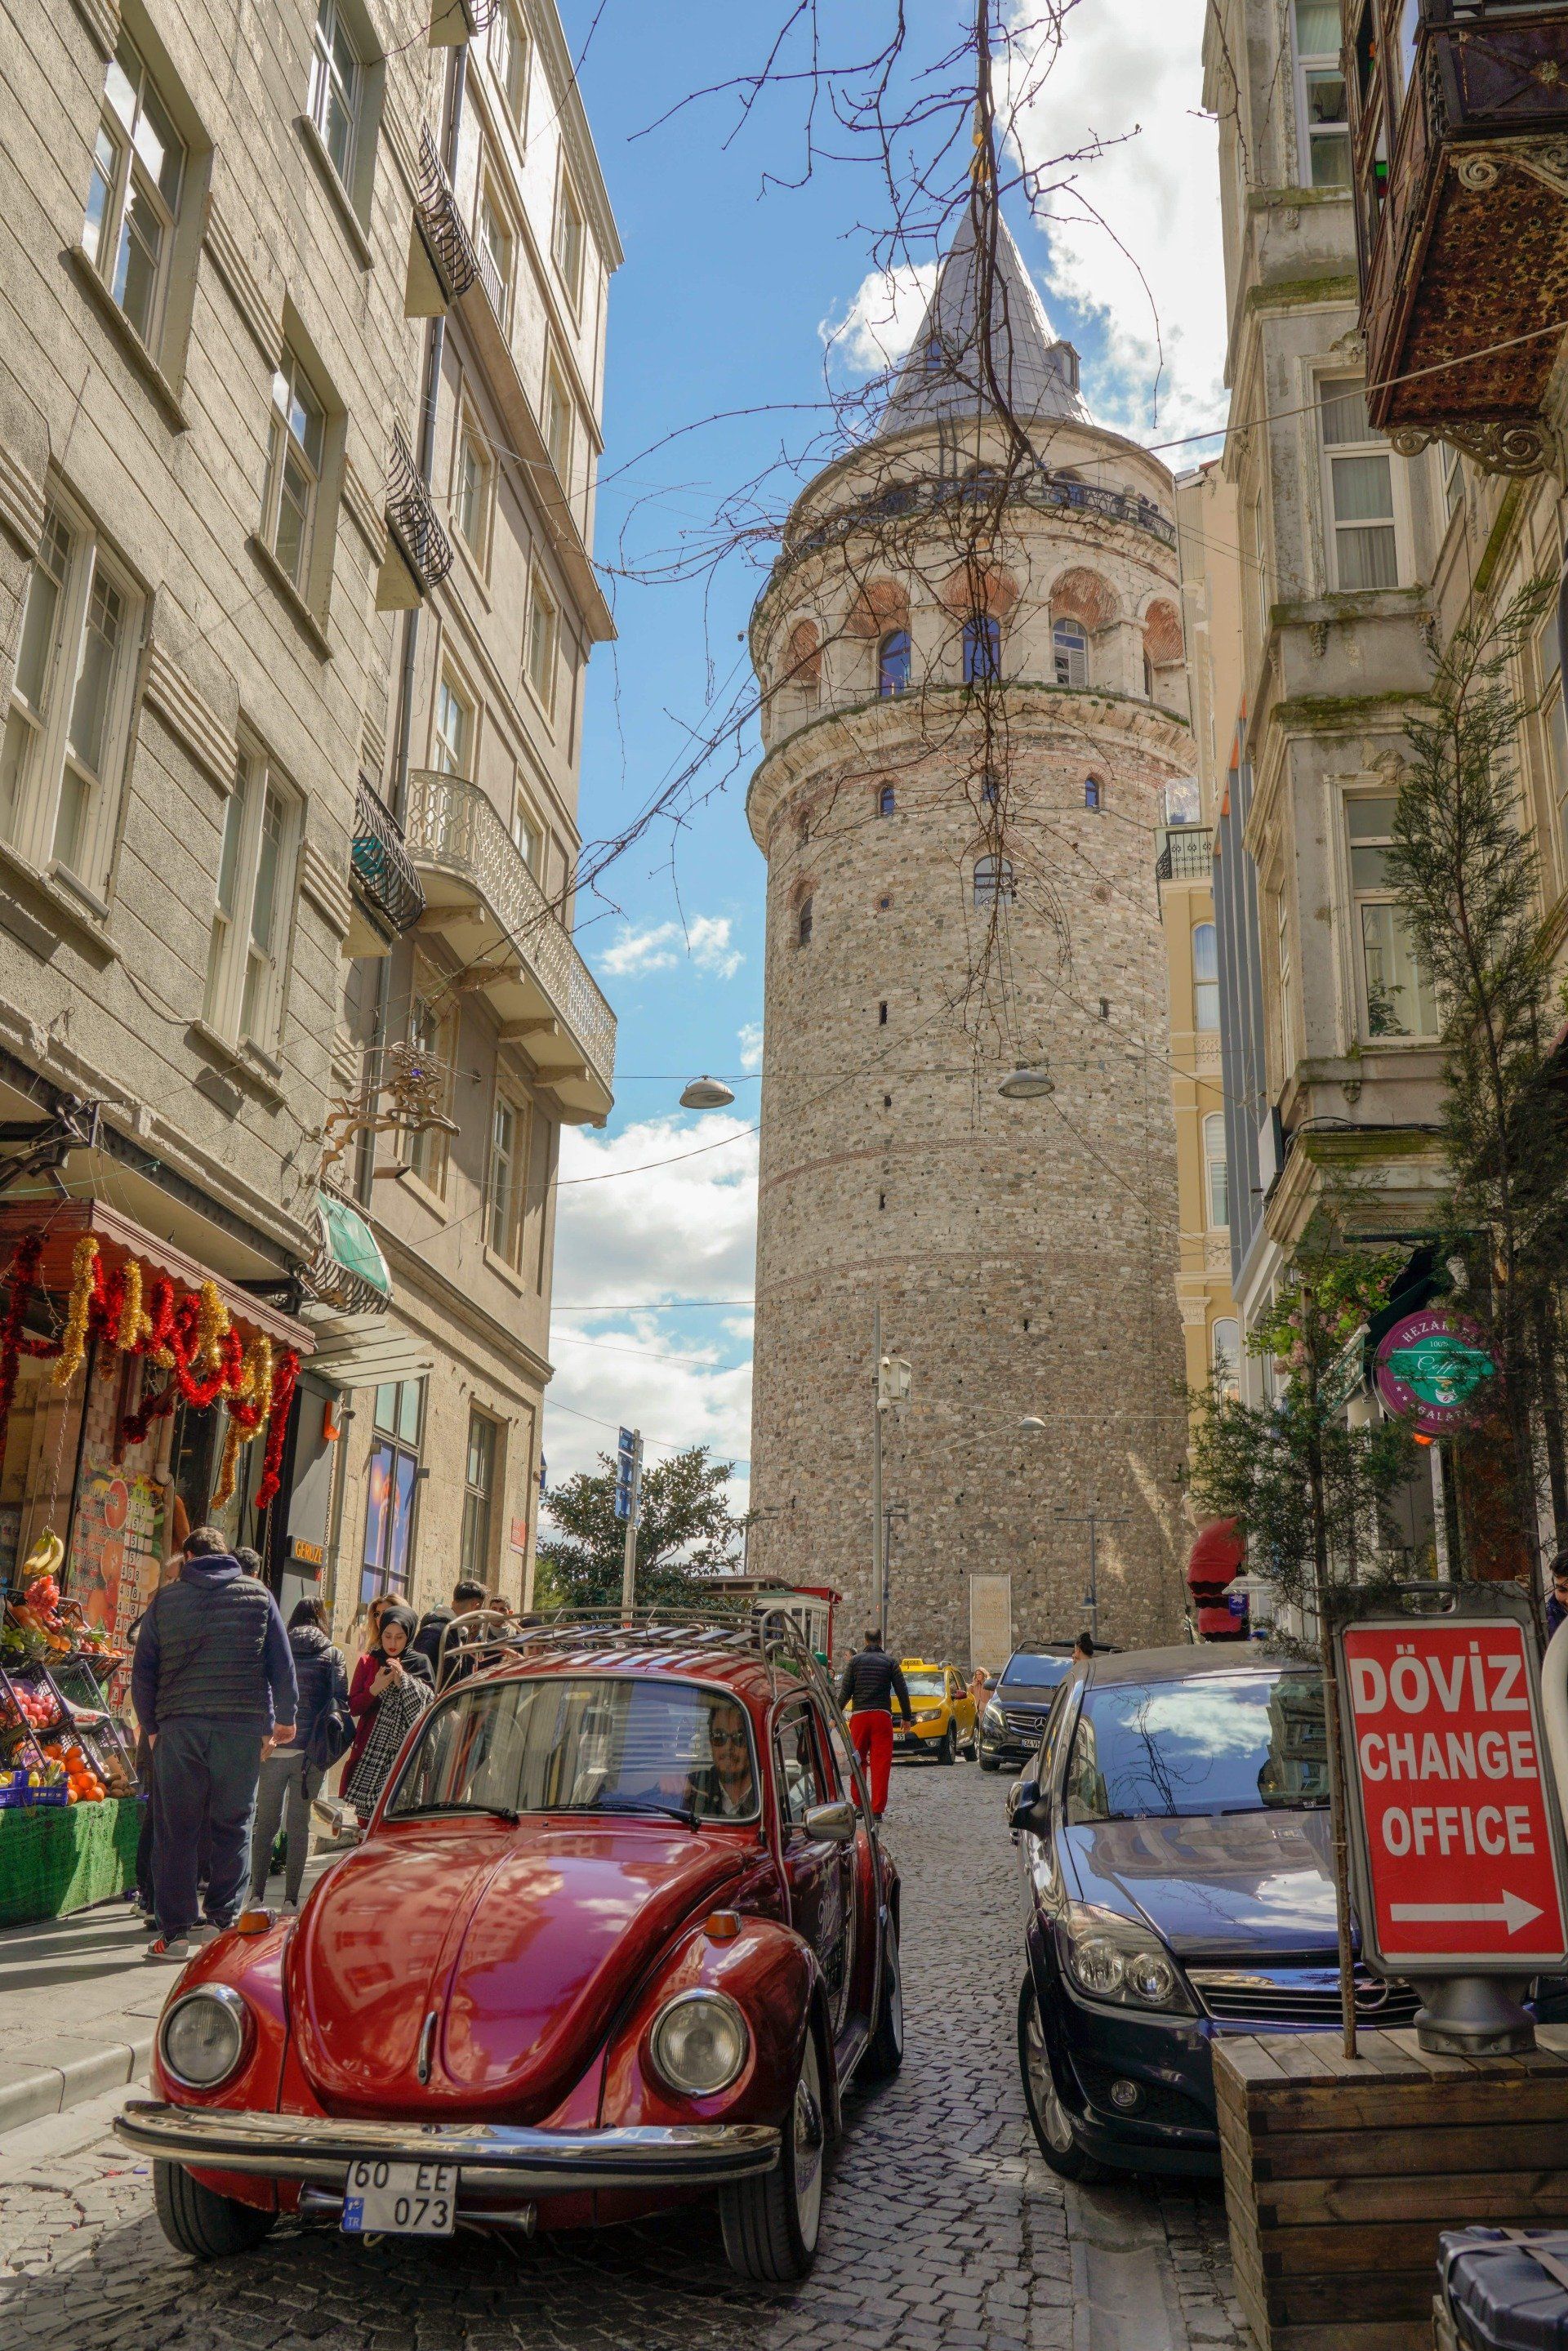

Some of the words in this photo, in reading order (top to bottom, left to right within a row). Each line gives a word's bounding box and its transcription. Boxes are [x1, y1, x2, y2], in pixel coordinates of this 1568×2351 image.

[1349, 1641, 1529, 1713] DÖVİZ
[1360, 1730, 1538, 1782] CHANGE
[1382, 1806, 1535, 1856] OFFICE
[355, 2161, 389, 2188] 60
[416, 2164, 452, 2192] EE
[348, 2216, 359, 2227] TR
[395, 2197, 448, 2228] 073
